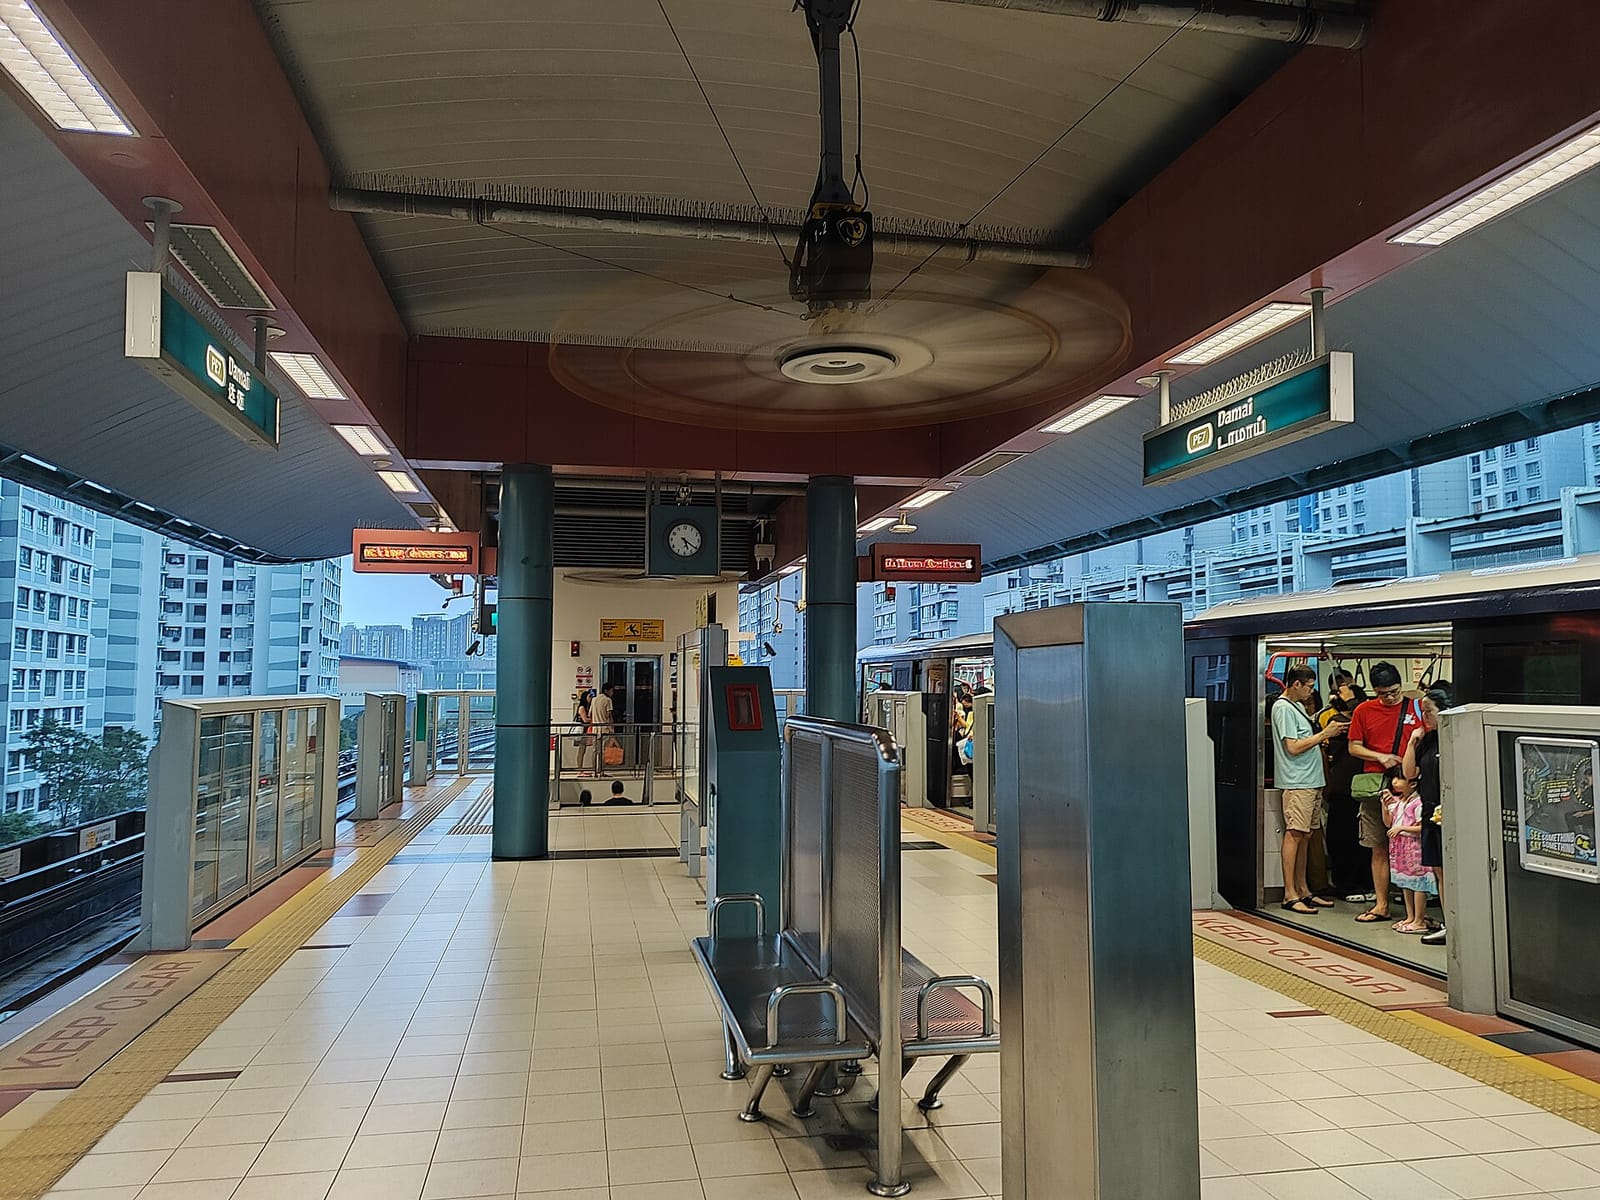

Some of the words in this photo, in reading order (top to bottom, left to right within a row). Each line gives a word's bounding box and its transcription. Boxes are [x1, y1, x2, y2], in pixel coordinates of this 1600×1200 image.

[228, 356, 251, 391] Damai
[1217, 397, 1254, 428] Damai
[1192, 431, 1207, 447] PE7
[1530, 829, 1542, 841] SEE
[1194, 917, 1281, 946] KEEP
[1268, 947, 1407, 994] CLEAR
[2, 1015, 118, 1071] KEEP
[94, 960, 201, 1012] CLEAR
